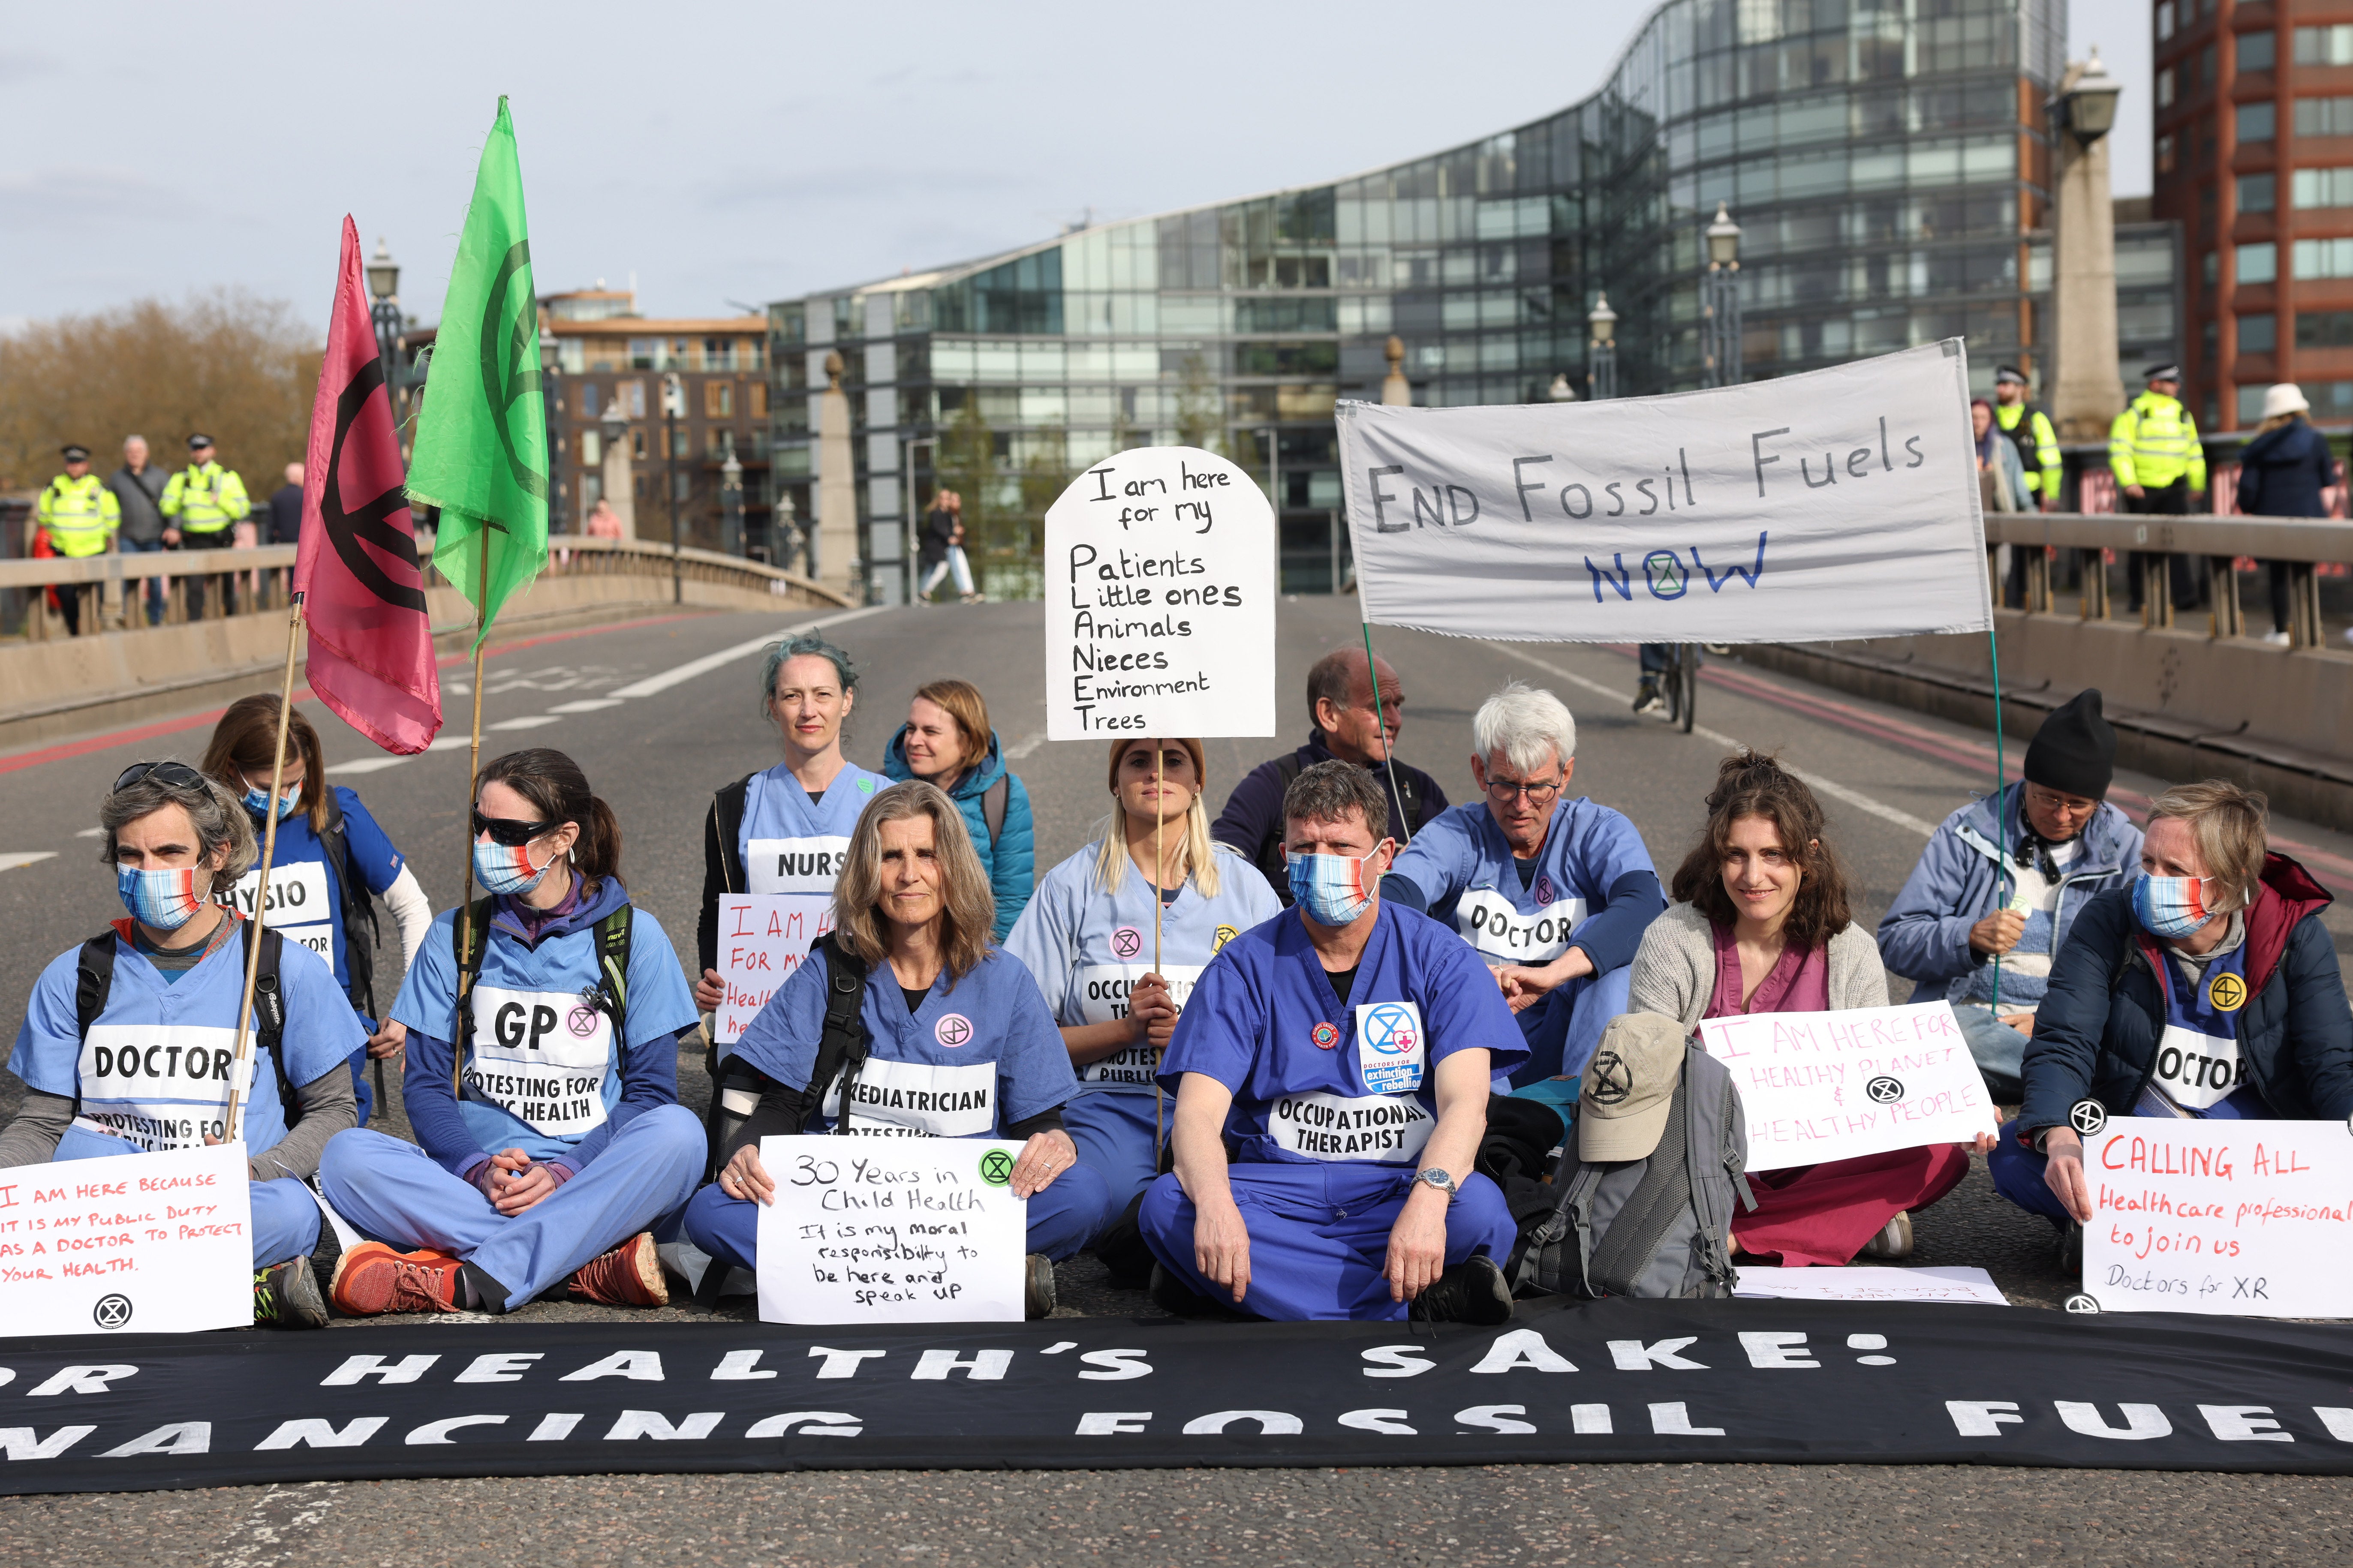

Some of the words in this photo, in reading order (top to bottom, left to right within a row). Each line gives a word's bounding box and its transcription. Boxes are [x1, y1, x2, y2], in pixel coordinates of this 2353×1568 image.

[1089, 468, 1116, 502] I
[1125, 479, 1166, 496] am
[1182, 461, 1230, 490] here
[1369, 465, 1480, 533] END
[1514, 448, 1696, 523] Fossil
[1752, 416, 1924, 497] Fuels
[1119, 508, 1159, 530] for
[1176, 501, 1212, 534] my
[1071, 544, 1205, 583] Patients
[1584, 530, 1767, 603] NOW
[1071, 585, 1152, 609] Little
[1165, 585, 1242, 607] ones
[1074, 611, 1192, 639] Animals
[1073, 643, 1168, 672] Nieces
[1074, 672, 1210, 701] Environment
[1074, 704, 1146, 731] Trees
[778, 852, 844, 876] NURS
[731, 906, 754, 937] I
[768, 910, 803, 940] AM
[1471, 905, 1571, 947] DOCTOR
[731, 948, 771, 971] FOR
[727, 982, 777, 1007] Healt
[495, 1001, 558, 1050] GP
[1313, 1024, 1322, 1035] CLIMATE
[1711, 1020, 1750, 1059] I
[1774, 1021, 1820, 1053] AM
[1828, 1018, 1907, 1051] HERE
[1913, 1012, 1959, 1040] FOR
[1329, 1037, 1337, 1047] CRISIS
[95, 1045, 232, 1081] DOCTOR
[1367, 1066, 1412, 1080] extinction
[1751, 1063, 1845, 1090] HEALTHY
[1858, 1048, 1956, 1080] PLANET
[2158, 1047, 2247, 1090] OCTOR
[567, 1077, 599, 1096] FOR
[1382, 1076, 1420, 1090] rebellion
[523, 1098, 590, 1121] HEALTH
[1279, 1098, 1426, 1130] OCCUPATIONAL
[1752, 1111, 1877, 1143] HEALTHY
[1890, 1084, 1977, 1124] PEOPLE
[1298, 1129, 1405, 1153] THERAPIST
[791, 1155, 839, 1186] 30
[852, 1158, 920, 1185] Years
[935, 1167, 959, 1184] in
[2102, 1135, 2233, 1181] CALLING
[2254, 1143, 2310, 1177] ALL
[0, 1185, 19, 1208] I
[34, 1187, 66, 1204] AM
[77, 1181, 128, 1199] HERE
[139, 1174, 217, 1192] BECAUSE
[822, 1190, 892, 1211] Child
[908, 1189, 986, 1212] Health
[1, 1220, 19, 1233] IT
[29, 1219, 46, 1231] IS
[54, 1216, 80, 1228] MY
[89, 1212, 155, 1227] PUBLIC
[167, 1205, 217, 1219] DUTY
[0, 1244, 24, 1257] AS
[32, 1241, 46, 1255] A
[58, 1232, 134, 1252] DOCTOR
[146, 1229, 167, 1241] TO
[179, 1223, 241, 1240] PROTECT
[799, 1224, 825, 1240] It
[837, 1223, 856, 1237] is
[865, 1225, 898, 1251] my
[910, 1221, 967, 1236] moral
[2111, 1224, 2133, 1245] to
[2136, 1226, 2201, 1259] join
[2215, 1240, 2241, 1256] us
[957, 1246, 978, 1259] to
[1, 1268, 53, 1282] YOUR
[63, 1258, 138, 1277] HEALTH.
[813, 1264, 839, 1283] be
[846, 1266, 897, 1285] here
[906, 1271, 943, 1284] and
[2104, 1264, 2188, 1295] Doctors
[2199, 1275, 2224, 1300] for
[2232, 1277, 2269, 1299] XR
[853, 1289, 917, 1306] speak
[1360, 1328, 1896, 1378] SAKE:
